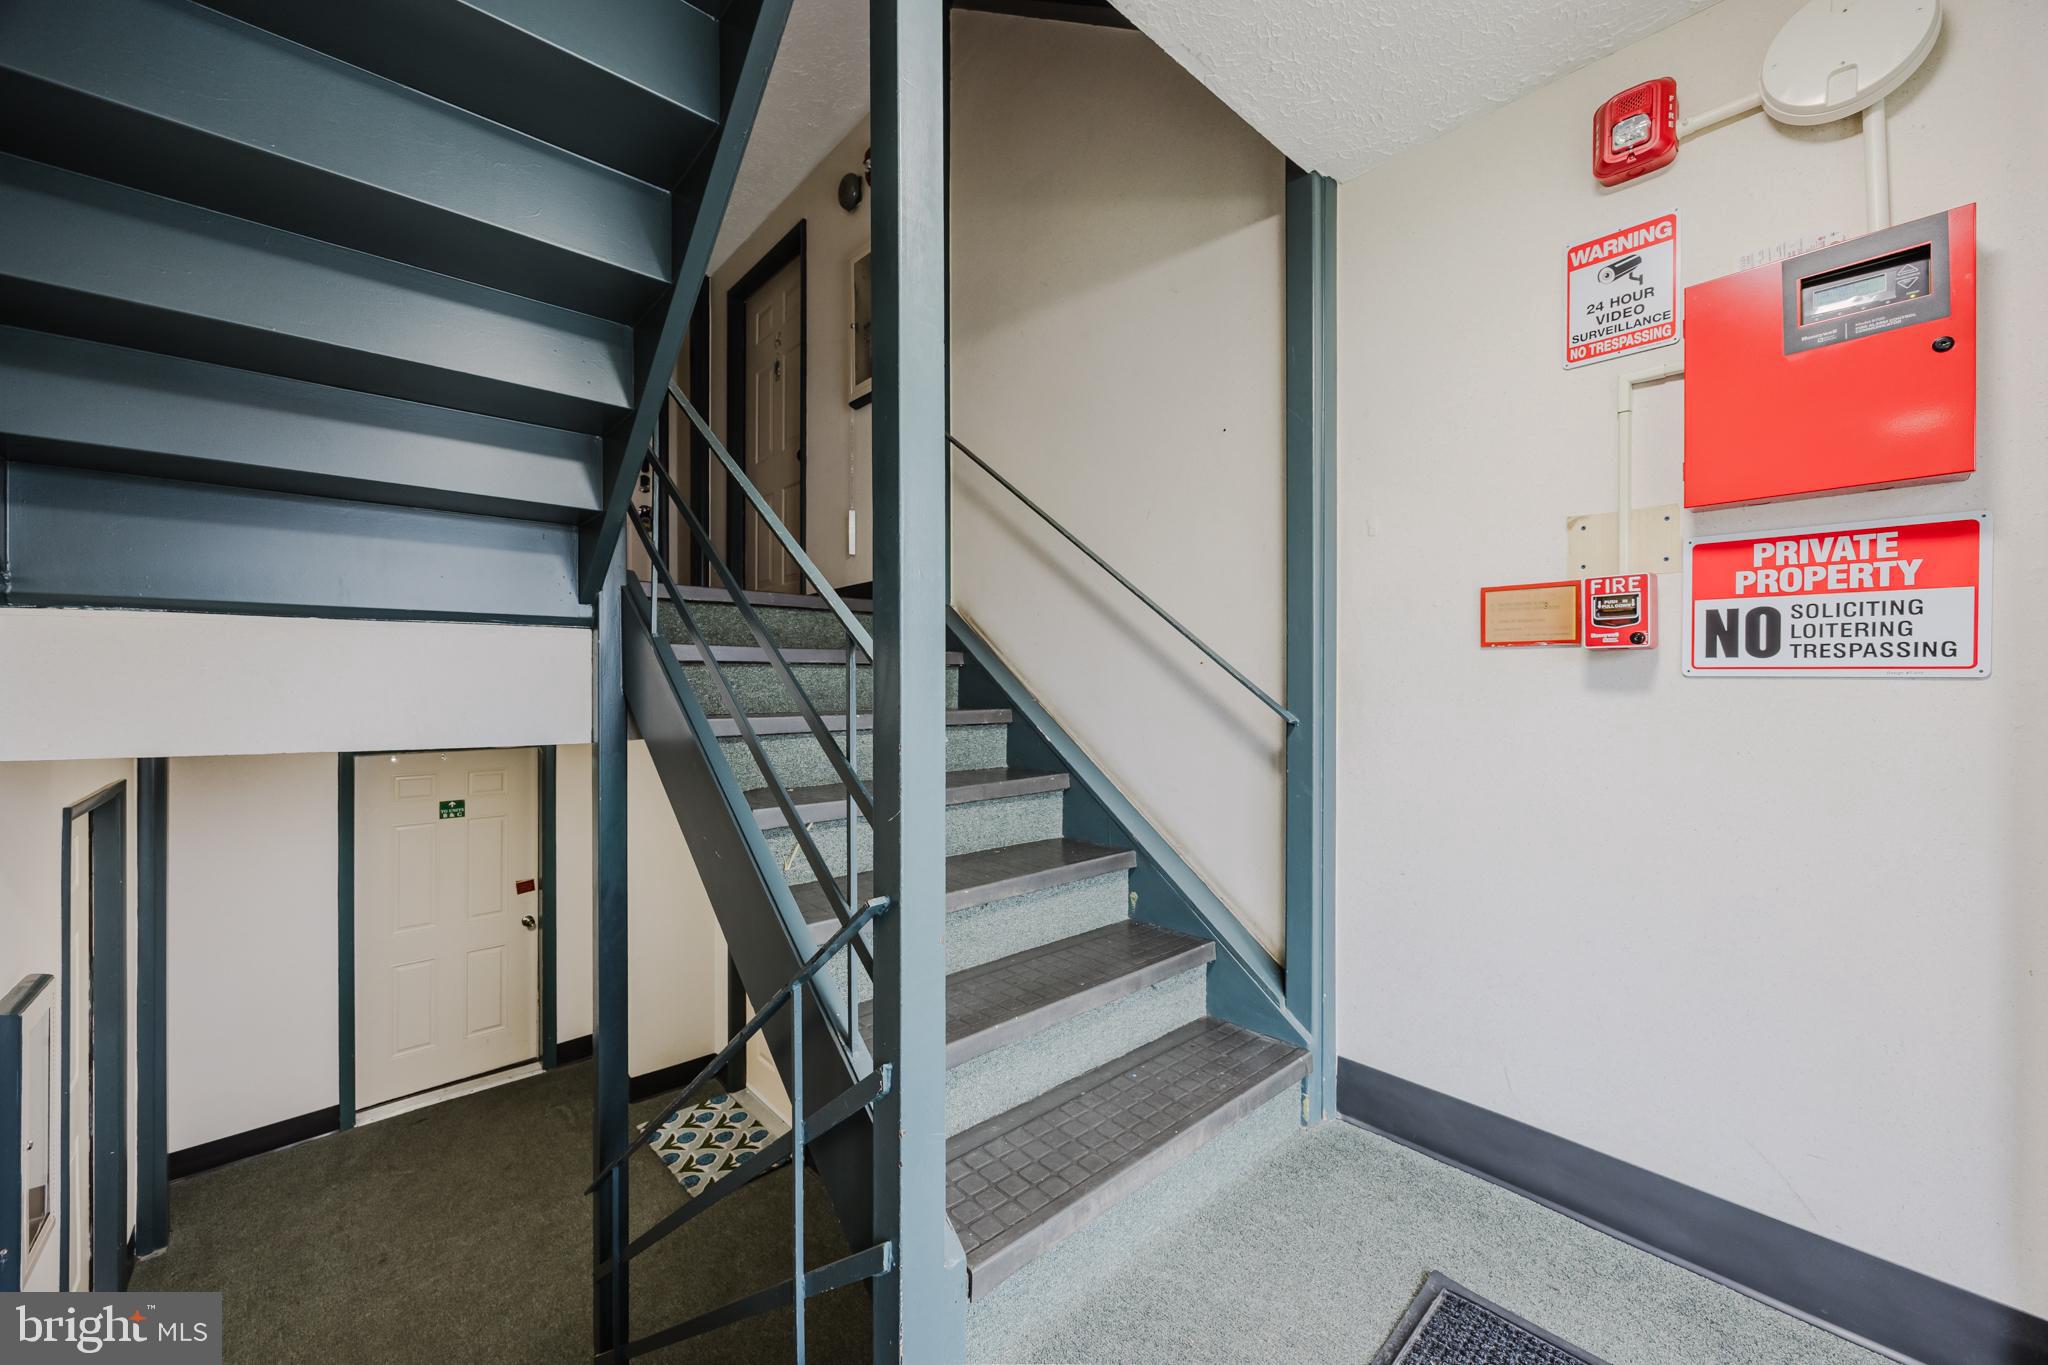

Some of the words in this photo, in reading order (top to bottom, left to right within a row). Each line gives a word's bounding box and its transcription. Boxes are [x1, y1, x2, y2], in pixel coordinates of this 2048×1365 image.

[1667, 95, 1675, 128] FIRE
[1570, 221, 1672, 267] WARNING
[1586, 301, 1604, 315] 24
[1610, 287, 1655, 308] HOUR
[1596, 304, 1645, 325] VIDEO
[1570, 347, 1587, 360] NO
[1589, 325, 1672, 355] TRESPASSING
[1572, 310, 1671, 344] SURVEILLANCE
[1753, 531, 1899, 567] PRIVATE
[1591, 576, 1641, 594] FIRE
[1735, 559, 1923, 595] PROPERTY
[1790, 599, 1924, 619] SOLICITING
[1705, 606, 1782, 659] NO
[1790, 620, 1913, 639] LOITERING
[1790, 640, 1958, 659] TRESPASSING
